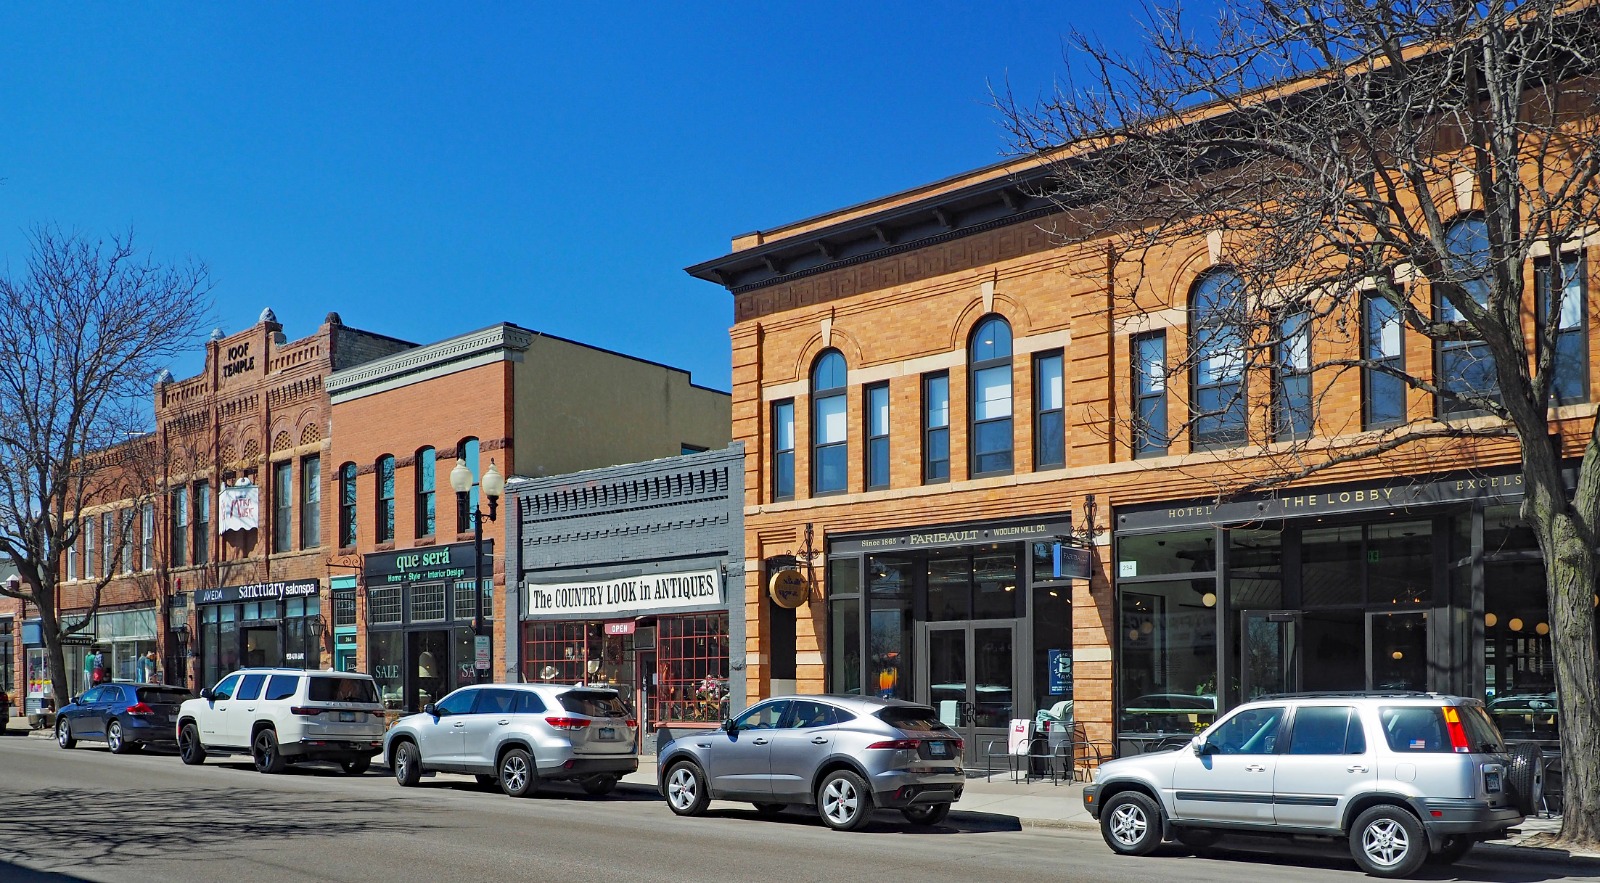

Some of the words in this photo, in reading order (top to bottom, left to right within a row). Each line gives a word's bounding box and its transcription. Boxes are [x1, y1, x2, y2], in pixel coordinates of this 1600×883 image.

[223, 356, 255, 378] TEMPLE
[1168, 506, 1213, 518] HOTEL
[1282, 494, 1317, 508] THE
[1328, 487, 1395, 504] LOBBY
[1456, 475, 1523, 491] EXCELS
[861, 539, 881, 547] Since
[881, 538, 897, 546] 1865
[909, 530, 979, 545] FARIBAULT
[993, 527, 1020, 536] WOOLEN
[1020, 526, 1036, 534] MILL
[396, 553, 420, 573] que
[422, 547, 450, 566] será
[387, 574, 402, 582] Home
[408, 572, 421, 581] Style
[427, 570, 446, 579] Interior
[446, 568, 465, 578] Design
[203, 589, 223, 601] AVEDA
[238, 582, 285, 601] sanctuary
[285, 582, 315, 596] salonspa
[533, 590, 552, 609] The
[555, 585, 605, 608] COUNTRY
[606, 581, 637, 605] LOOK
[640, 580, 651, 601] in
[654, 574, 714, 600] ANTIQUES
[611, 624, 628, 633] OPEN
[375, 664, 399, 678] SALE
